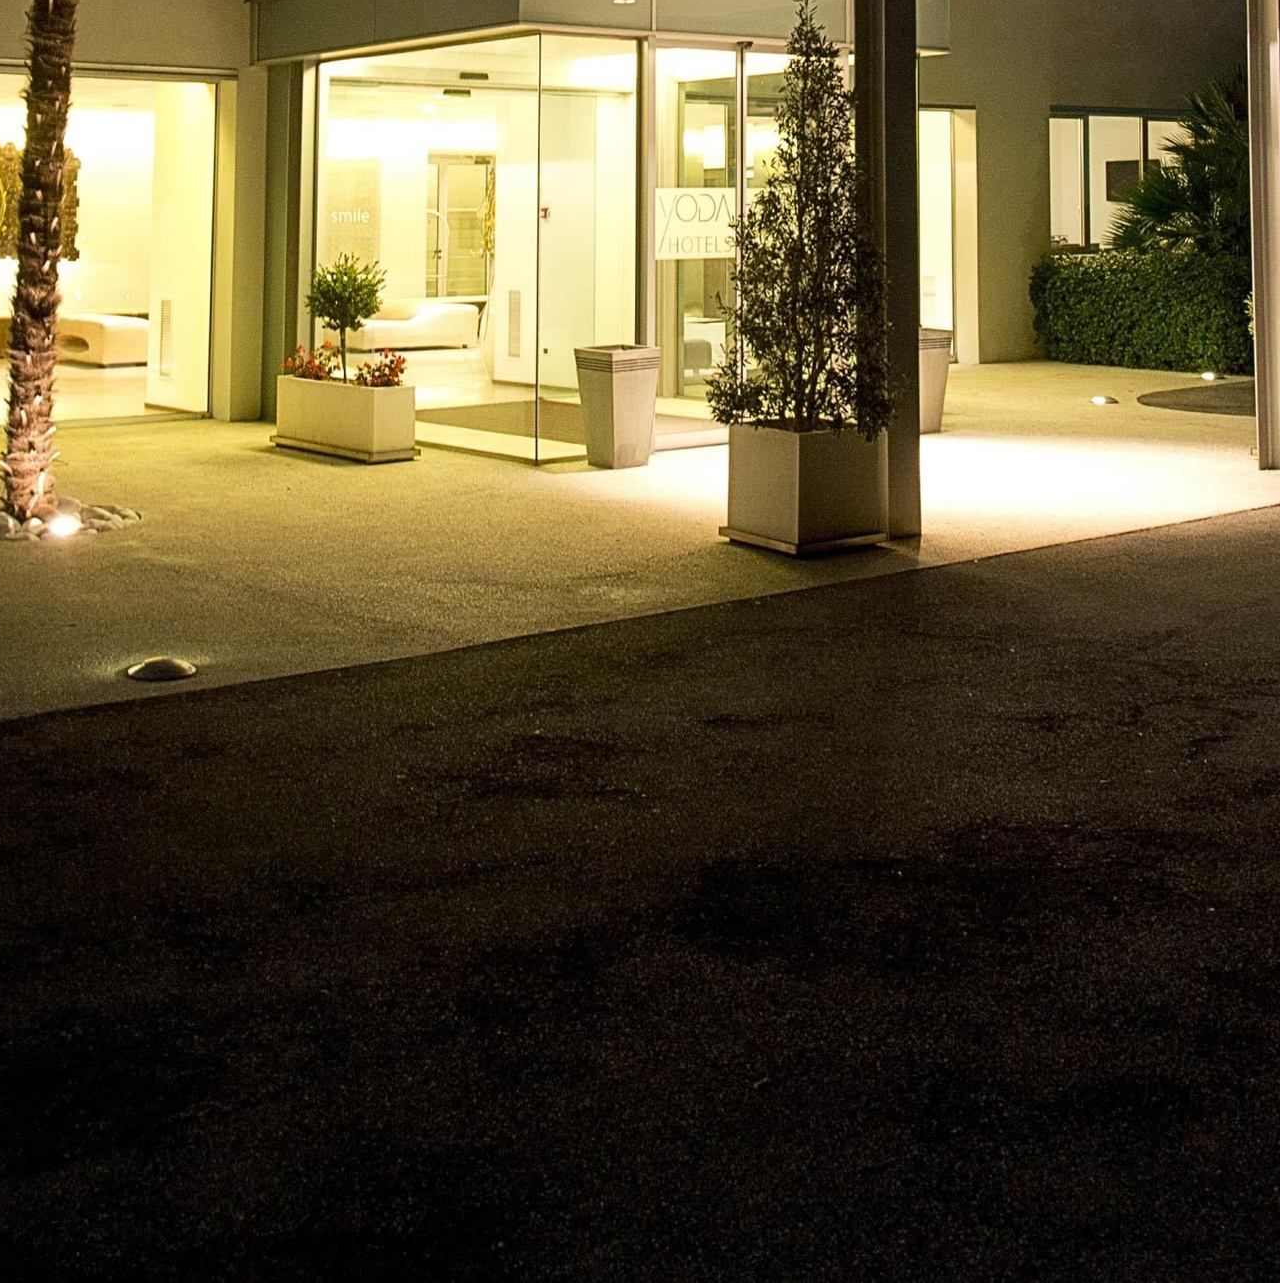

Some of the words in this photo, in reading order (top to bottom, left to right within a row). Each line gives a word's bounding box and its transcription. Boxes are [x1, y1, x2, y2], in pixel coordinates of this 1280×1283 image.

[330, 206, 371, 224] smile
[658, 192, 732, 253] YODA
[668, 235, 733, 254] HOTELS
